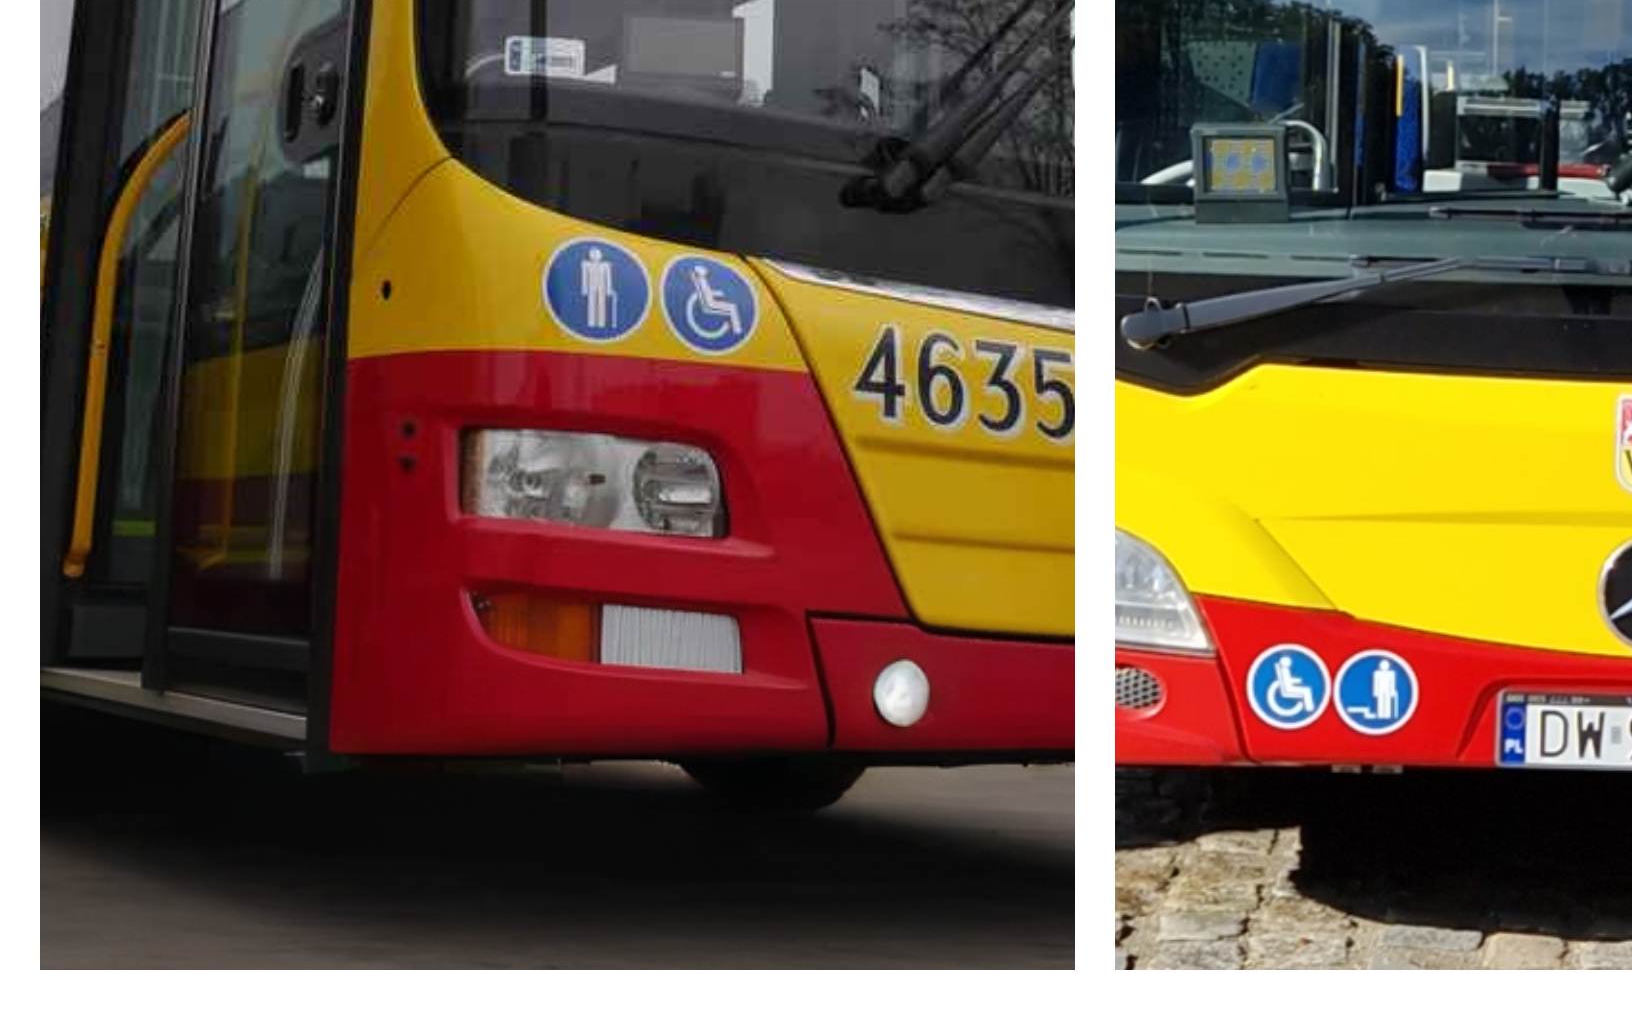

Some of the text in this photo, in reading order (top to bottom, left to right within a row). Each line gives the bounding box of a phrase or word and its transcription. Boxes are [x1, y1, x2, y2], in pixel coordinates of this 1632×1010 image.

[855, 324, 1074, 439] 4635
[1505, 738, 1524, 755] PL
[1539, 710, 1606, 759] DW
